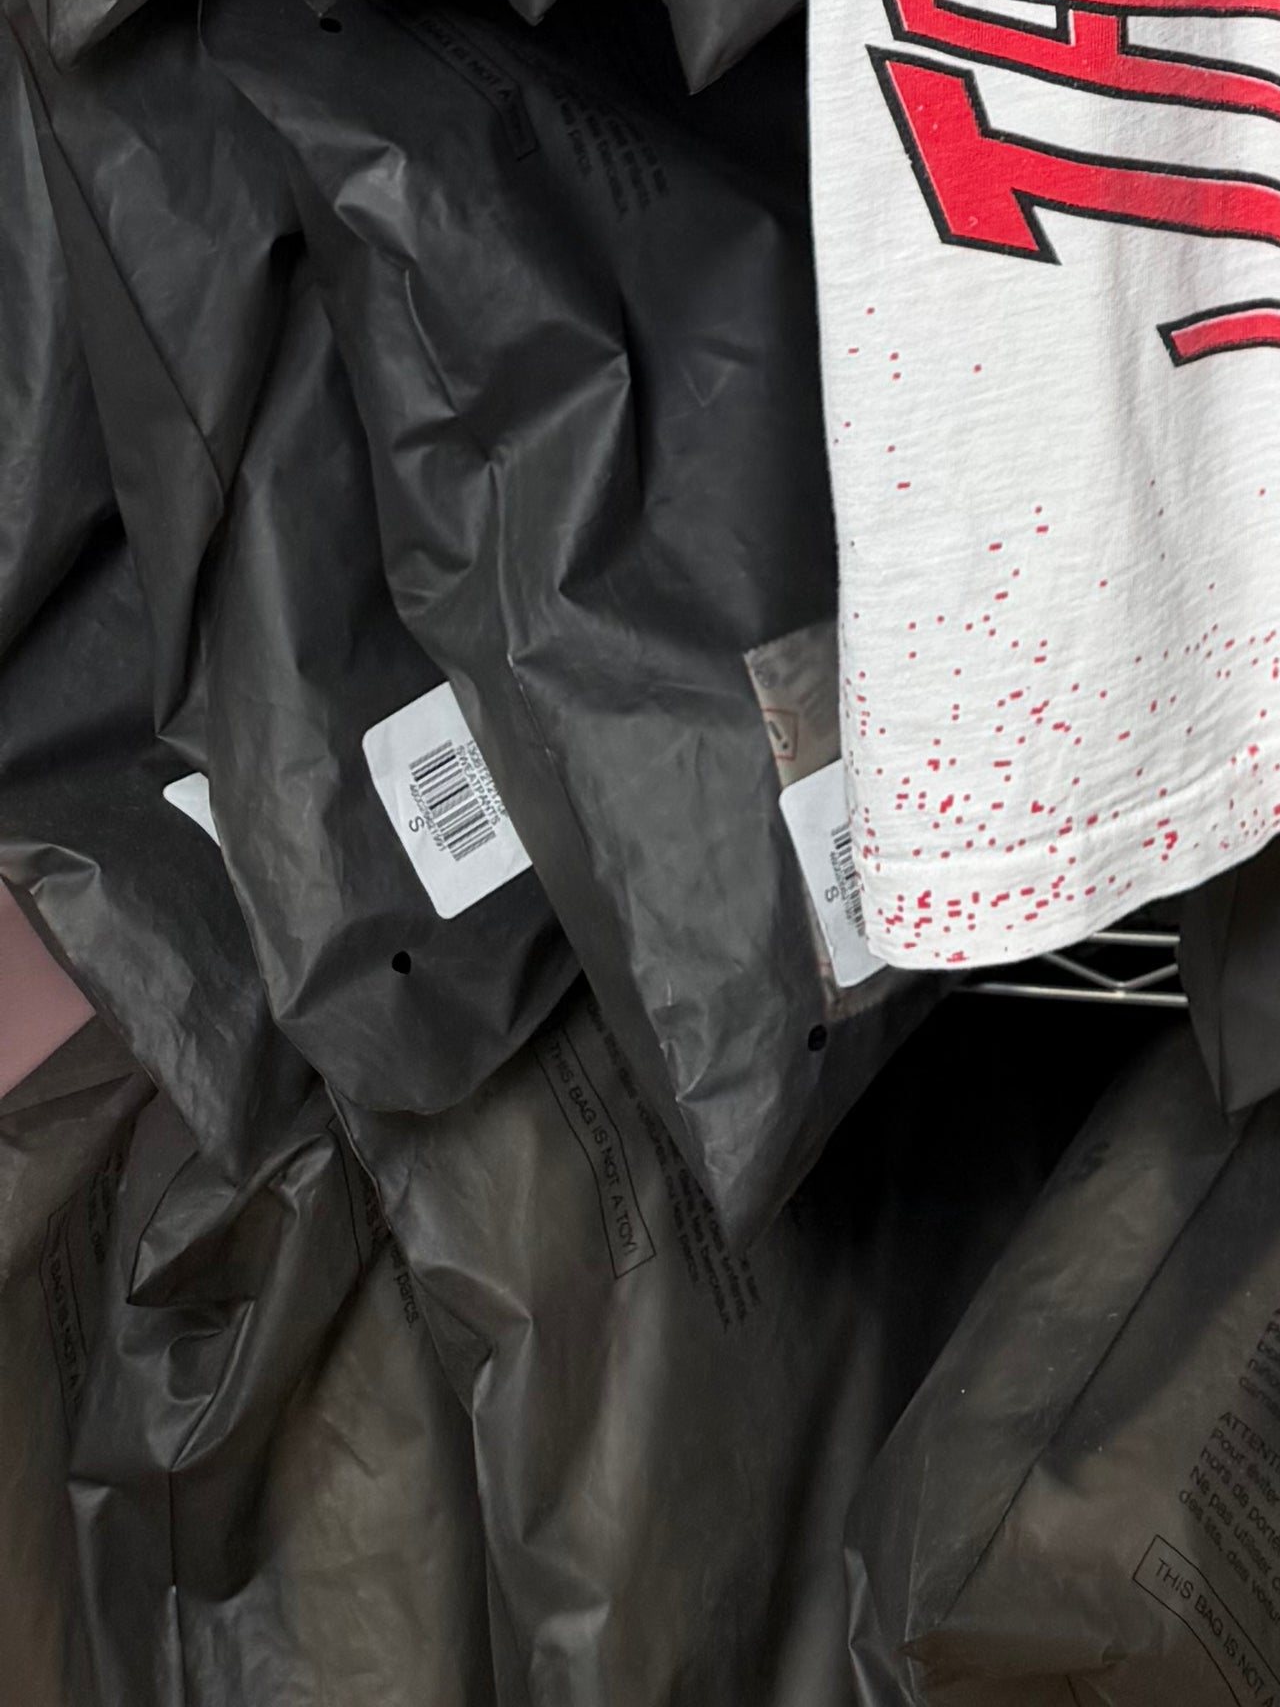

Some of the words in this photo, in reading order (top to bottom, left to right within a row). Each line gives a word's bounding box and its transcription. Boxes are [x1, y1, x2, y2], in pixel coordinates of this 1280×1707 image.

[452, 743, 503, 828] SWEATPANTS
[407, 814, 426, 834] S
[568, 1086, 599, 1128] BAG
[591, 1126, 614, 1148] IS
[610, 1193, 626, 1210] A
[1209, 1426, 1246, 1465] Pour
[1189, 1463, 1211, 1497] Ne
[1206, 1493, 1235, 1530] pas
[1154, 1555, 1196, 1602] THIS
[1192, 1596, 1226, 1639] BAG
[1221, 1630, 1243, 1660] IS
[1235, 1652, 1269, 1701] NOT
